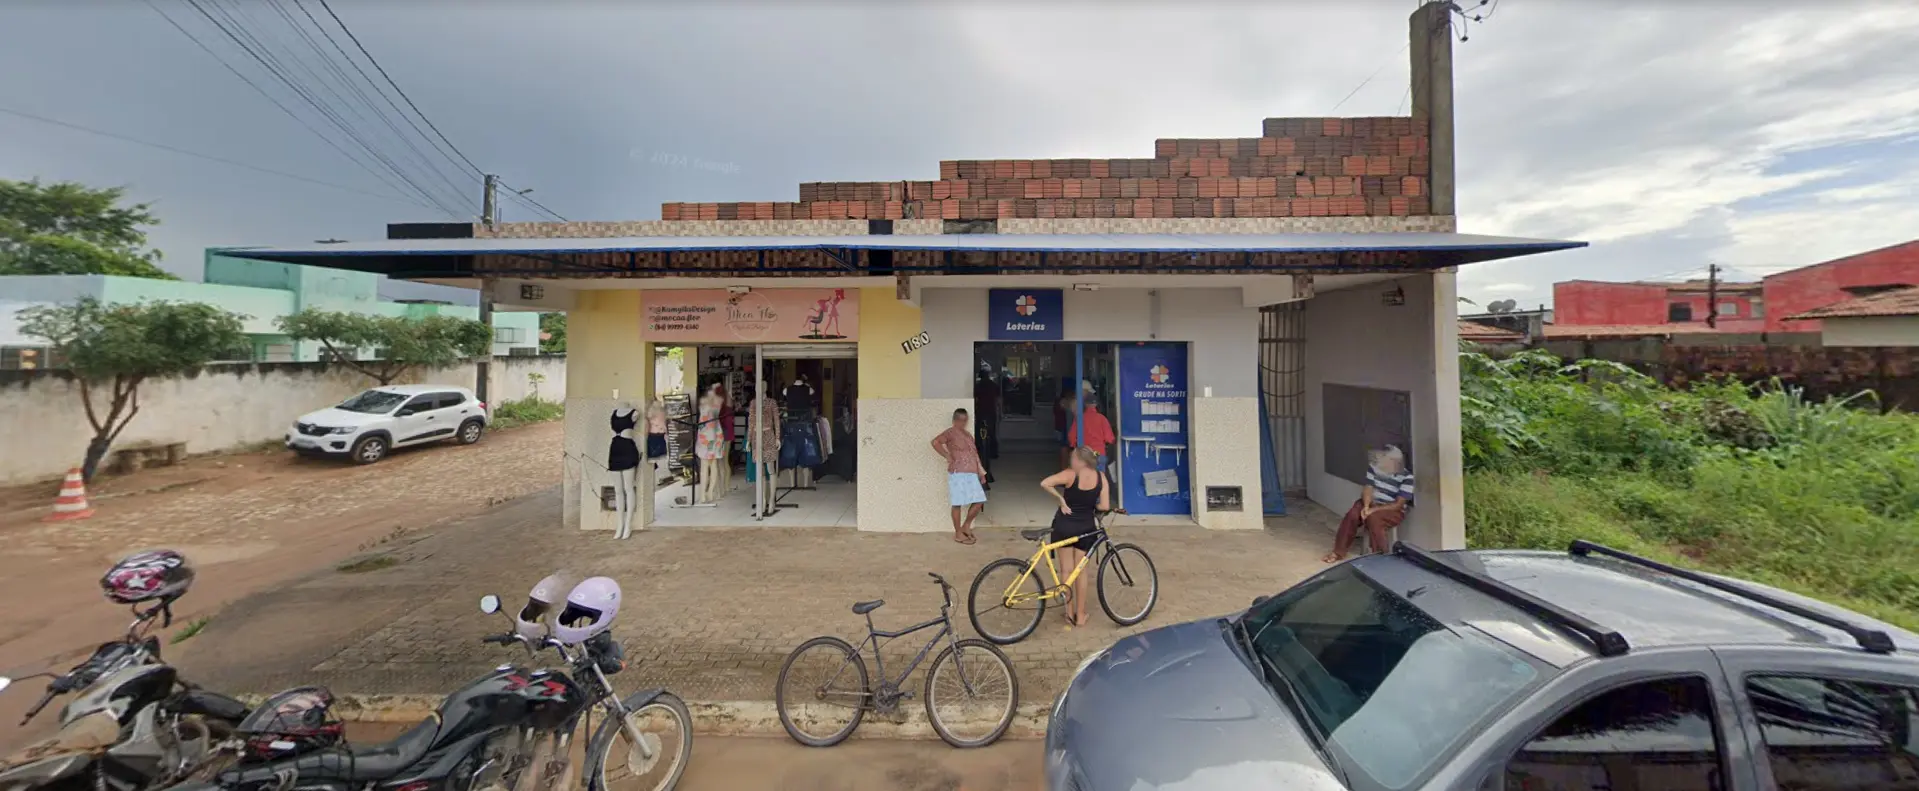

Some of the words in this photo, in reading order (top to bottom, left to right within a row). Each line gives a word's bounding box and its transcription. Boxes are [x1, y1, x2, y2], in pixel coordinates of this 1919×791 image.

[1006, 321, 1046, 331] Loterias
[902, 331, 931, 355] 180
[1133, 390, 1155, 398] GRUDE
[1156, 390, 1166, 398] NA
[1167, 390, 1187, 398] SORTE
